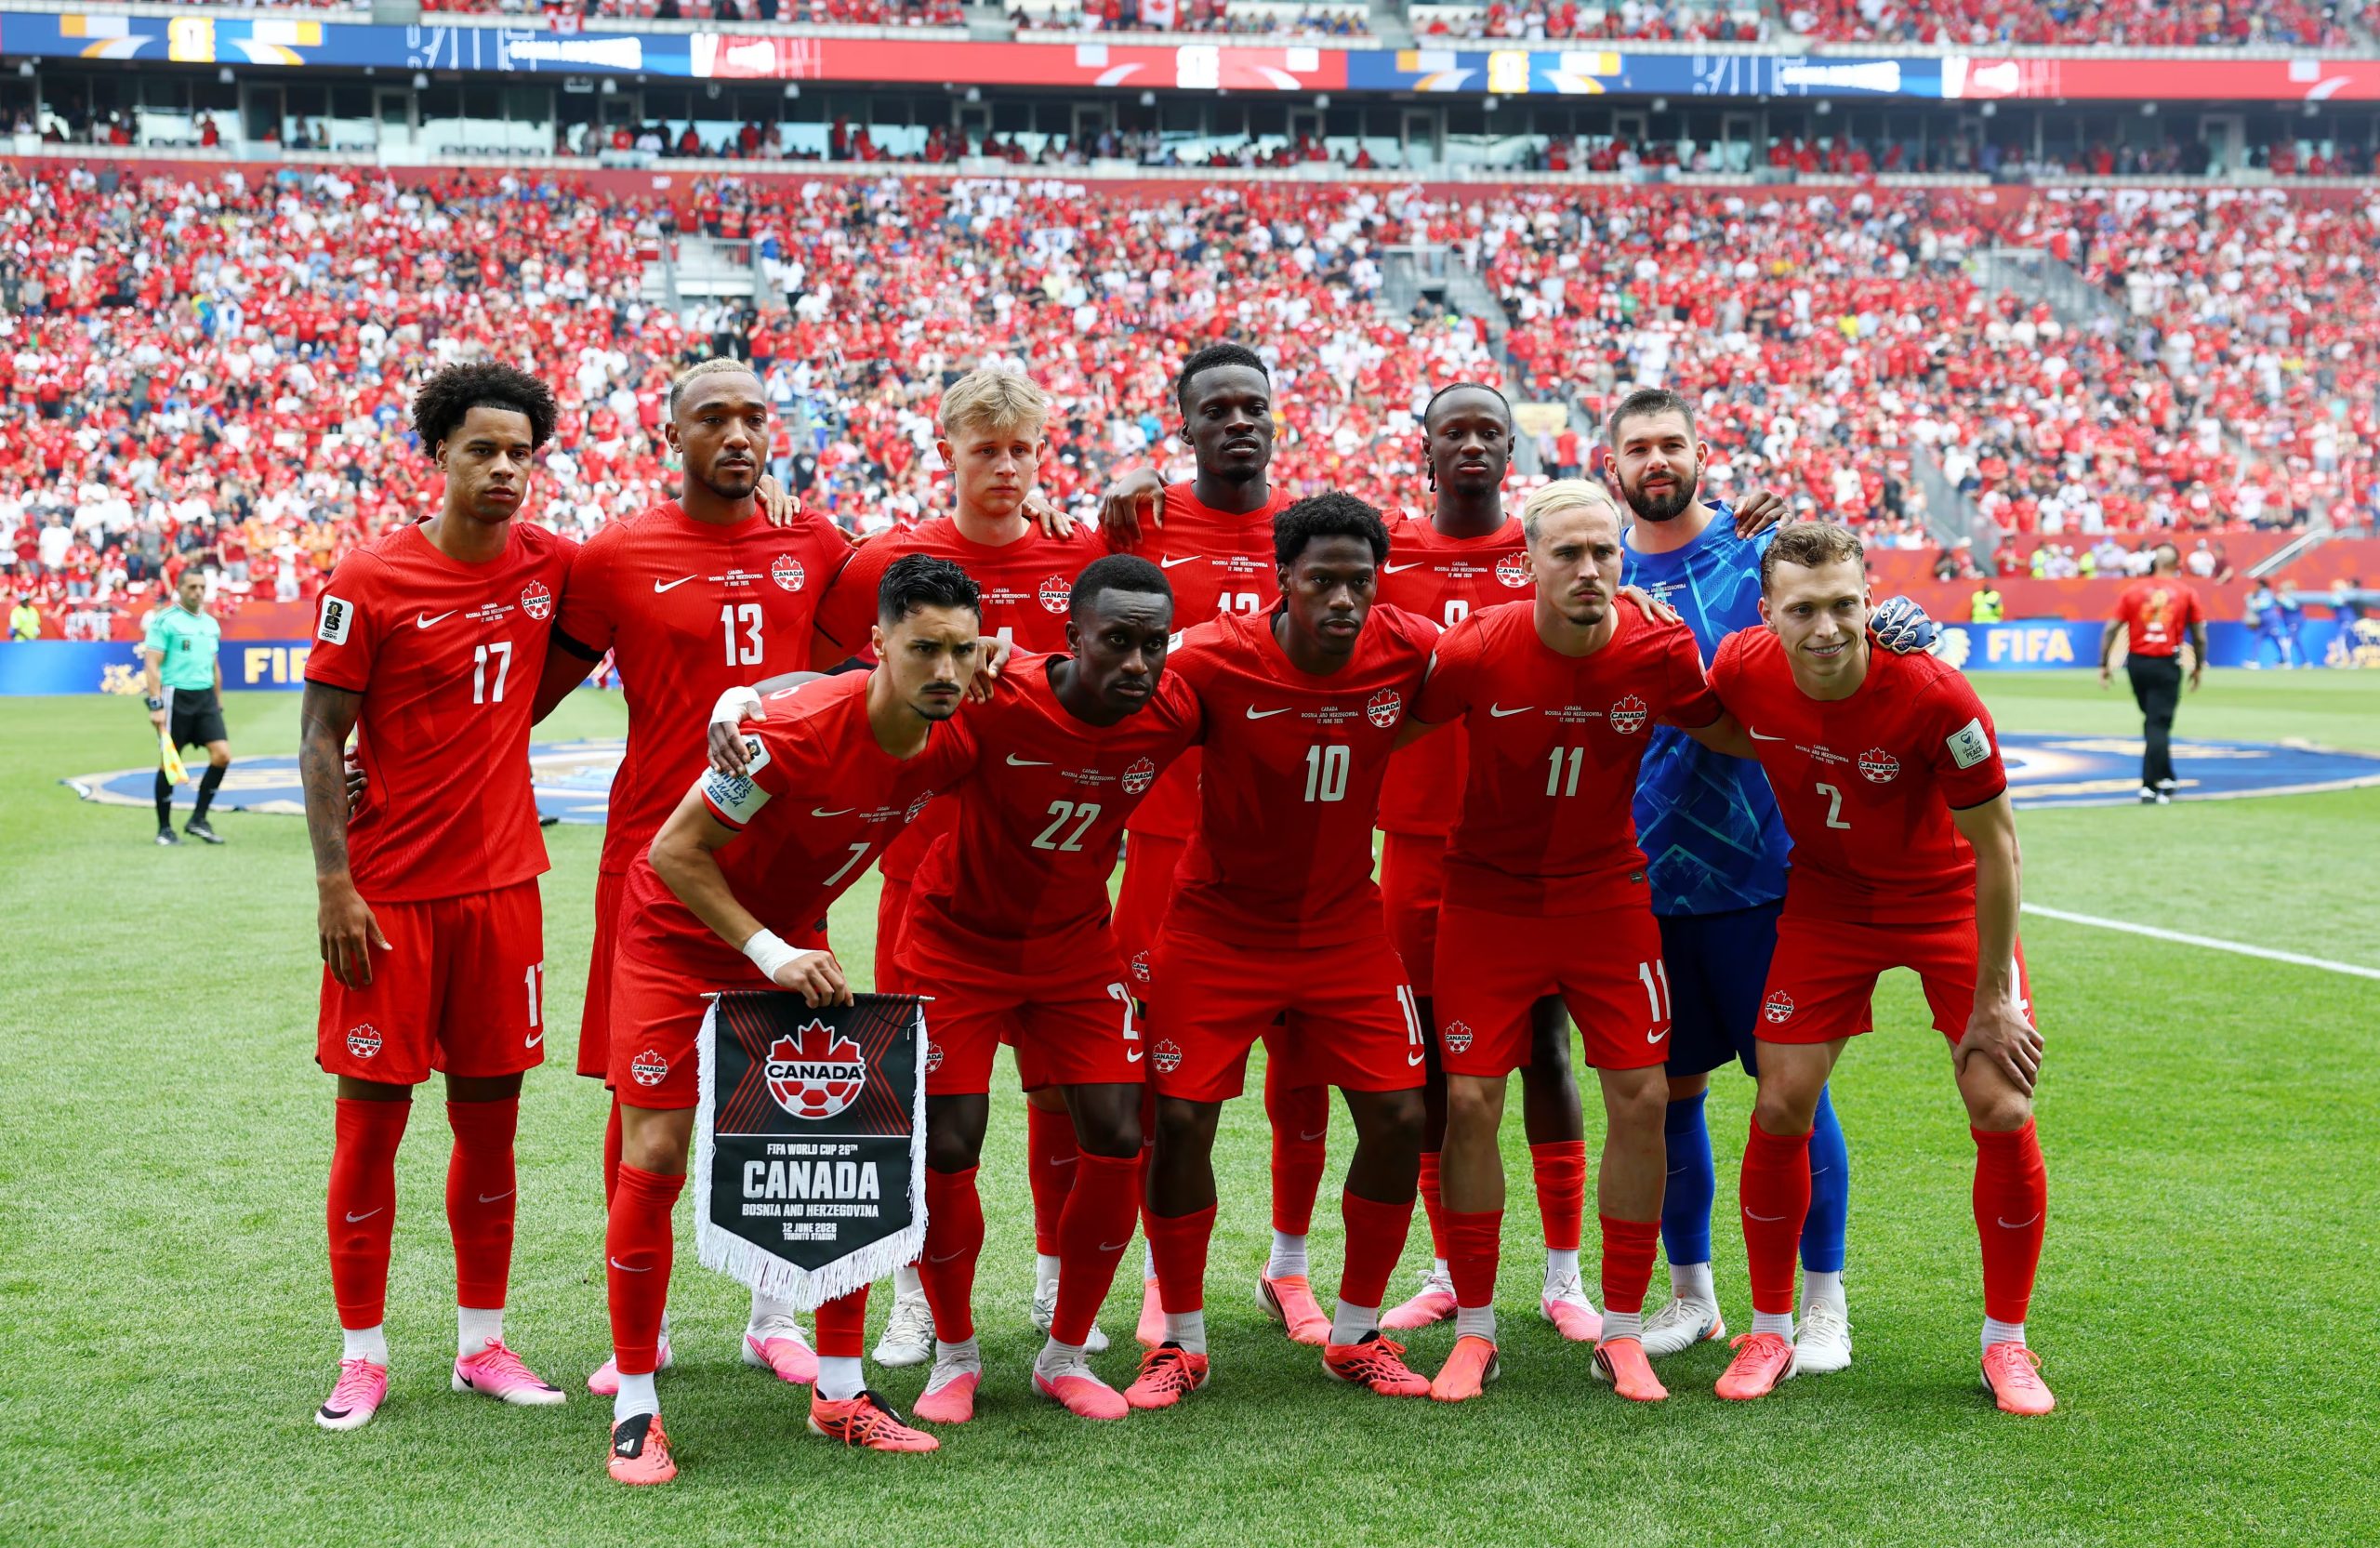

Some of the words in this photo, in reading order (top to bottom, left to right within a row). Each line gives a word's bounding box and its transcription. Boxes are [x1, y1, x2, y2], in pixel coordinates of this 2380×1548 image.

[522, 596, 549, 607] CANADA
[721, 603, 763, 667] 13
[1987, 628, 2074, 662] FIFA
[245, 647, 312, 684] FIF
[473, 641, 512, 705] 17
[1368, 702, 1400, 715] CANADA
[1611, 711, 1646, 720] CANADA
[1965, 746, 1984, 759] PEACE
[1304, 745, 1351, 802] 10
[1546, 747, 1584, 797] 11
[1859, 761, 1898, 771] CANADA
[721, 770, 749, 799] NITES
[736, 774, 754, 792] BALL
[1123, 772, 1153, 781] CANADA
[707, 787, 723, 804] FIFA
[716, 783, 745, 808] World
[1816, 782, 1851, 829] 2
[1030, 800, 1102, 852] 22
[822, 842, 871, 887] 7
[1132, 962, 1149, 971] CANA
[523, 961, 544, 1027] 1
[1639, 959, 1672, 1023] 11
[1106, 982, 1141, 1040] 2
[1765, 1003, 1792, 1012] CANADA
[348, 1037, 381, 1047] CANADA
[632, 1065, 667, 1073] CANADA
[767, 1065, 862, 1080] CANADA
[767, 1144, 787, 1156] FIFA
[787, 1144, 818, 1156] WORLD
[819, 1144, 838, 1156] CUP
[743, 1160, 880, 1199] CANADA
[742, 1203, 781, 1216] BOSNIA
[783, 1204, 804, 1217] AND
[806, 1204, 879, 1217] HERZEGOVINA
[782, 1223, 793, 1233] 12
[794, 1223, 813, 1233] JUNE
[814, 1223, 838, 1233] 2026
[783, 1232, 810, 1240] TORONTO
[811, 1233, 837, 1241] STADIUM
